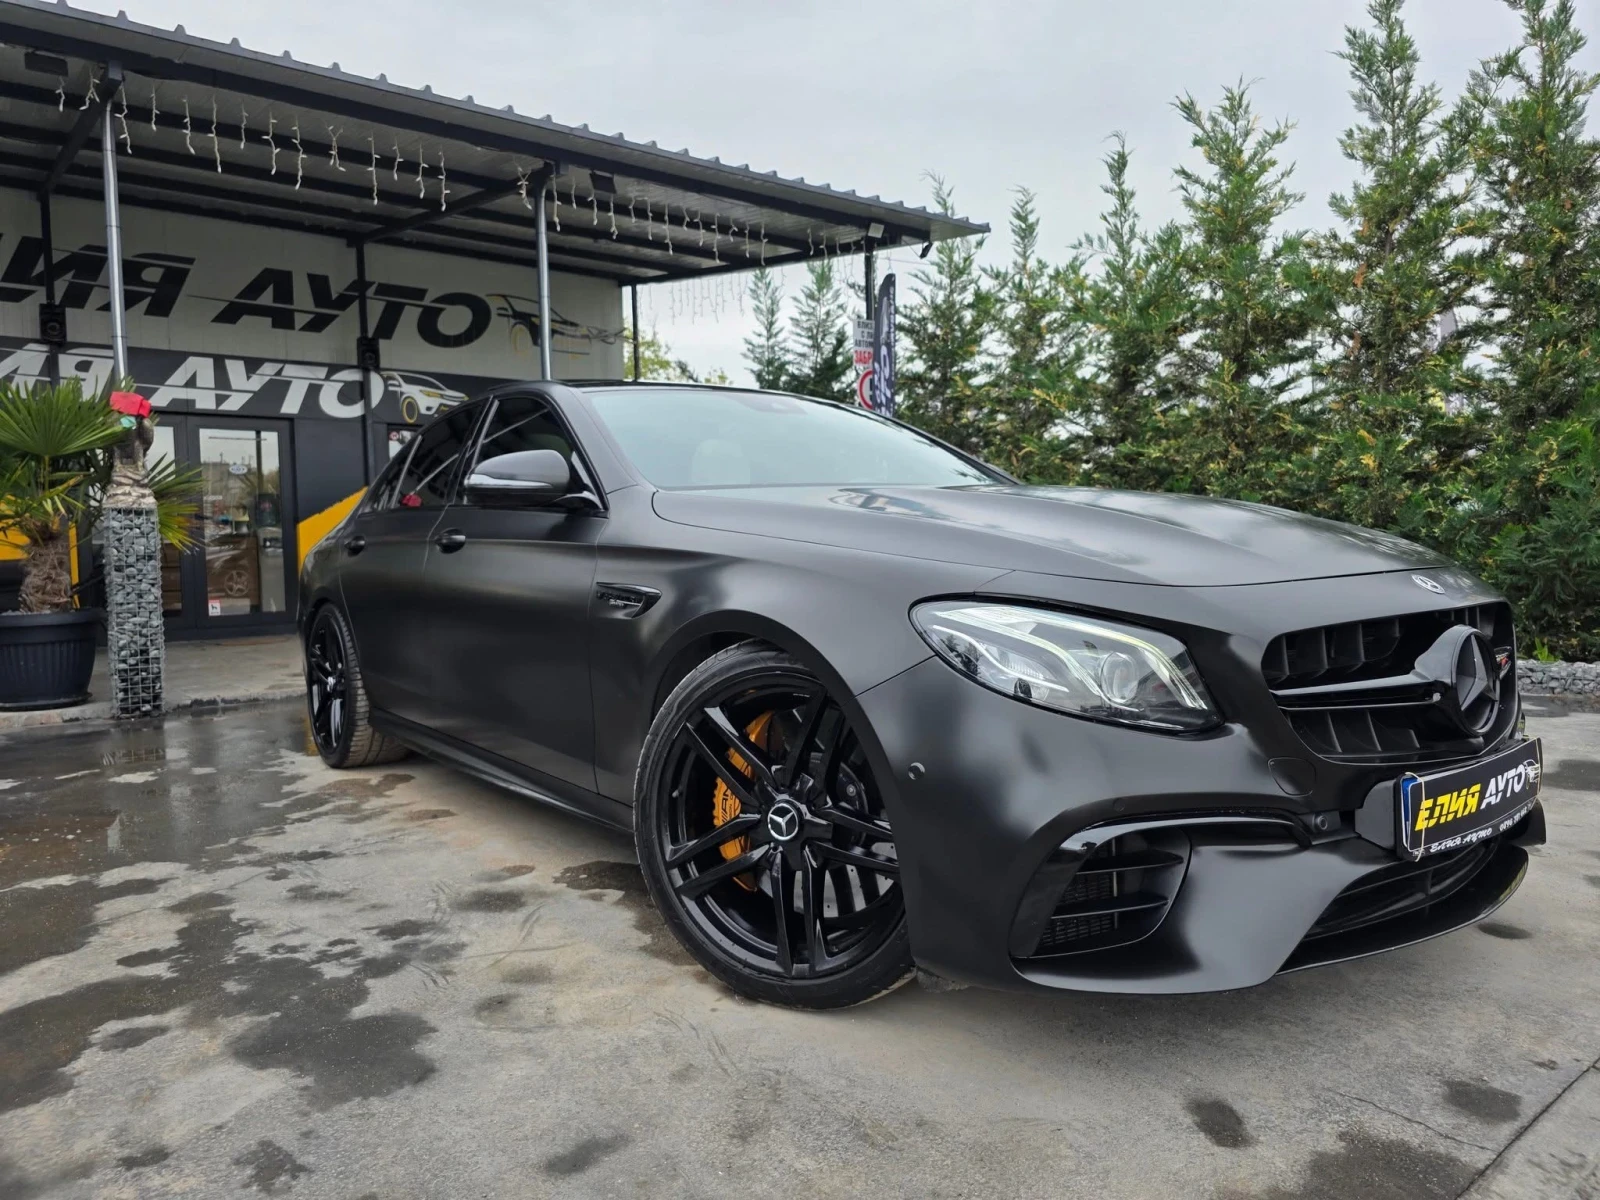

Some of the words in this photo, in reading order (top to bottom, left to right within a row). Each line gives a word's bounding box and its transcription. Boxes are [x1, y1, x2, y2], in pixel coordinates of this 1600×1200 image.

[0, 233, 196, 318] ИЯ
[210, 267, 492, 348] АУТО
[150, 355, 385, 419] АУТО
[1415, 784, 1481, 831] ЕЛИЯ
[1480, 764, 1525, 809] АУТО
